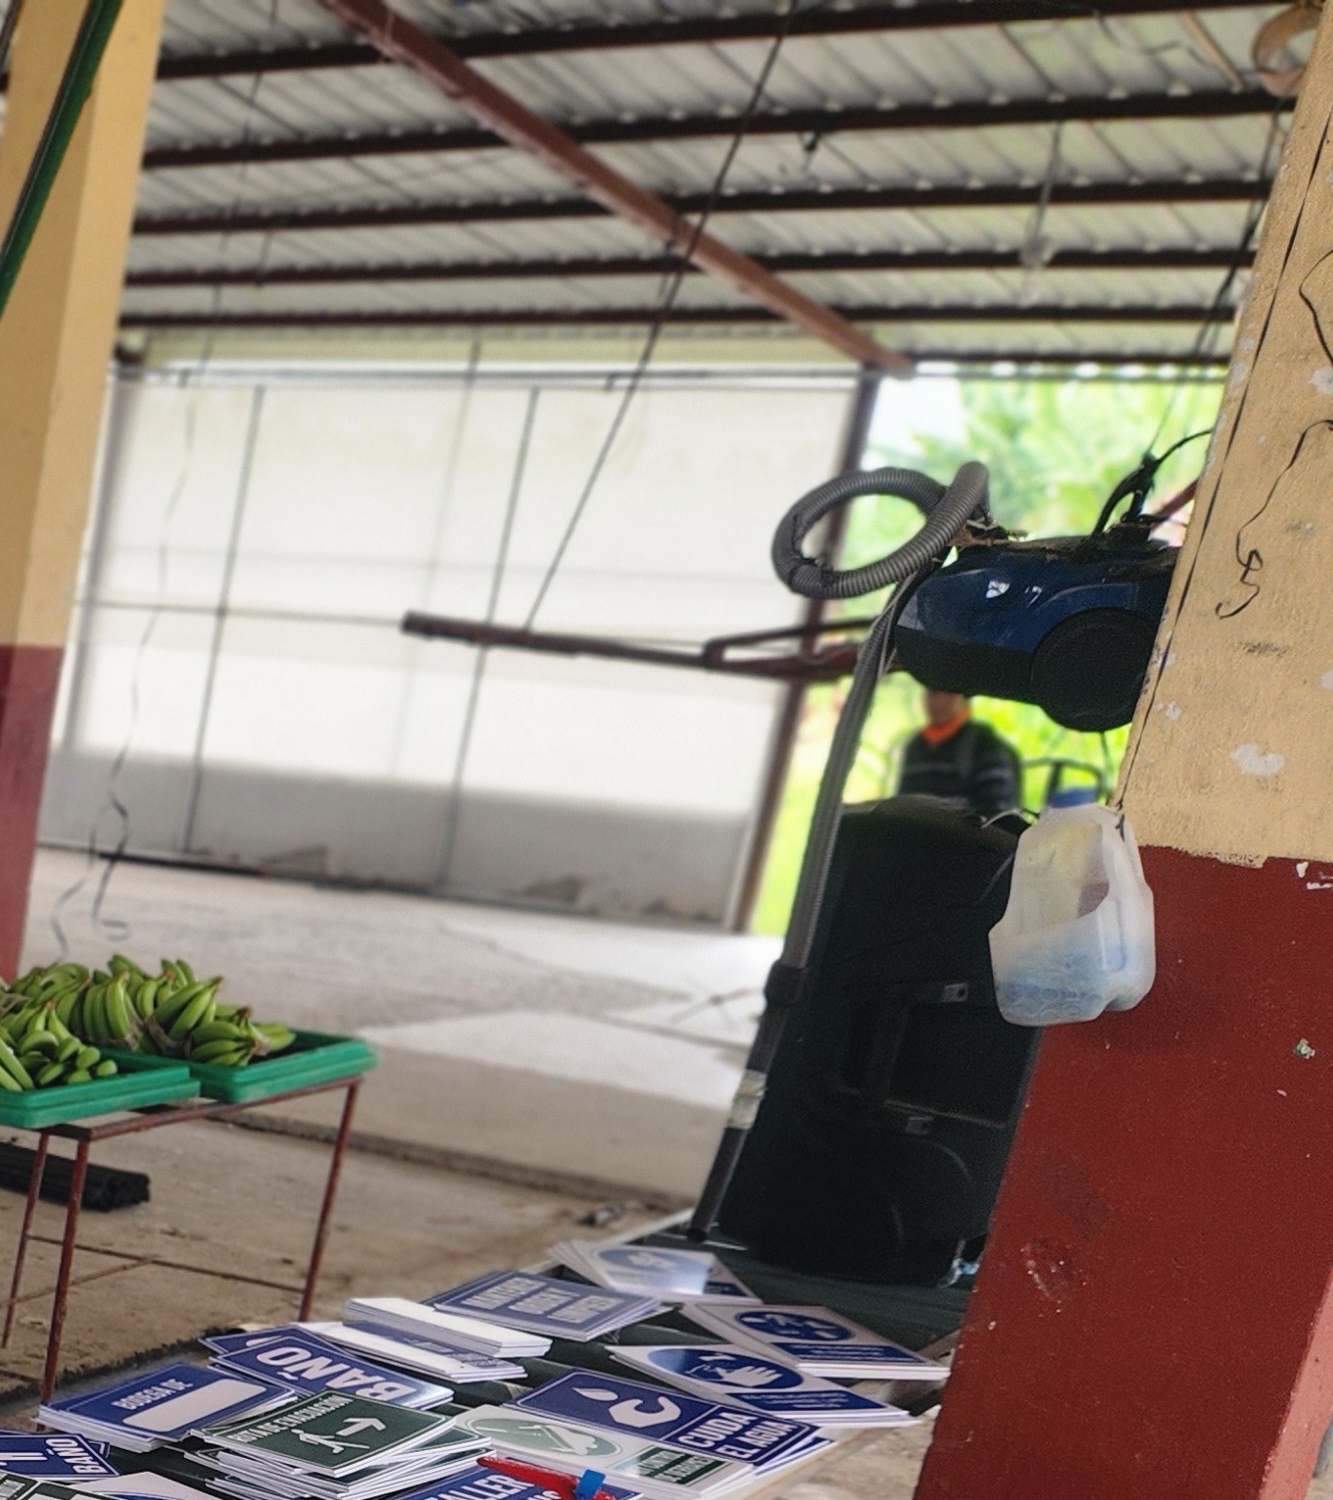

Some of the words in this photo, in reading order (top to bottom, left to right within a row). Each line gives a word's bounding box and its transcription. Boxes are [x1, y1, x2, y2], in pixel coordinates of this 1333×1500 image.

[256, 1347, 418, 1401] BAÑO
[678, 1412, 758, 1449] CUIDA
[46, 1438, 108, 1474] BAÑO
